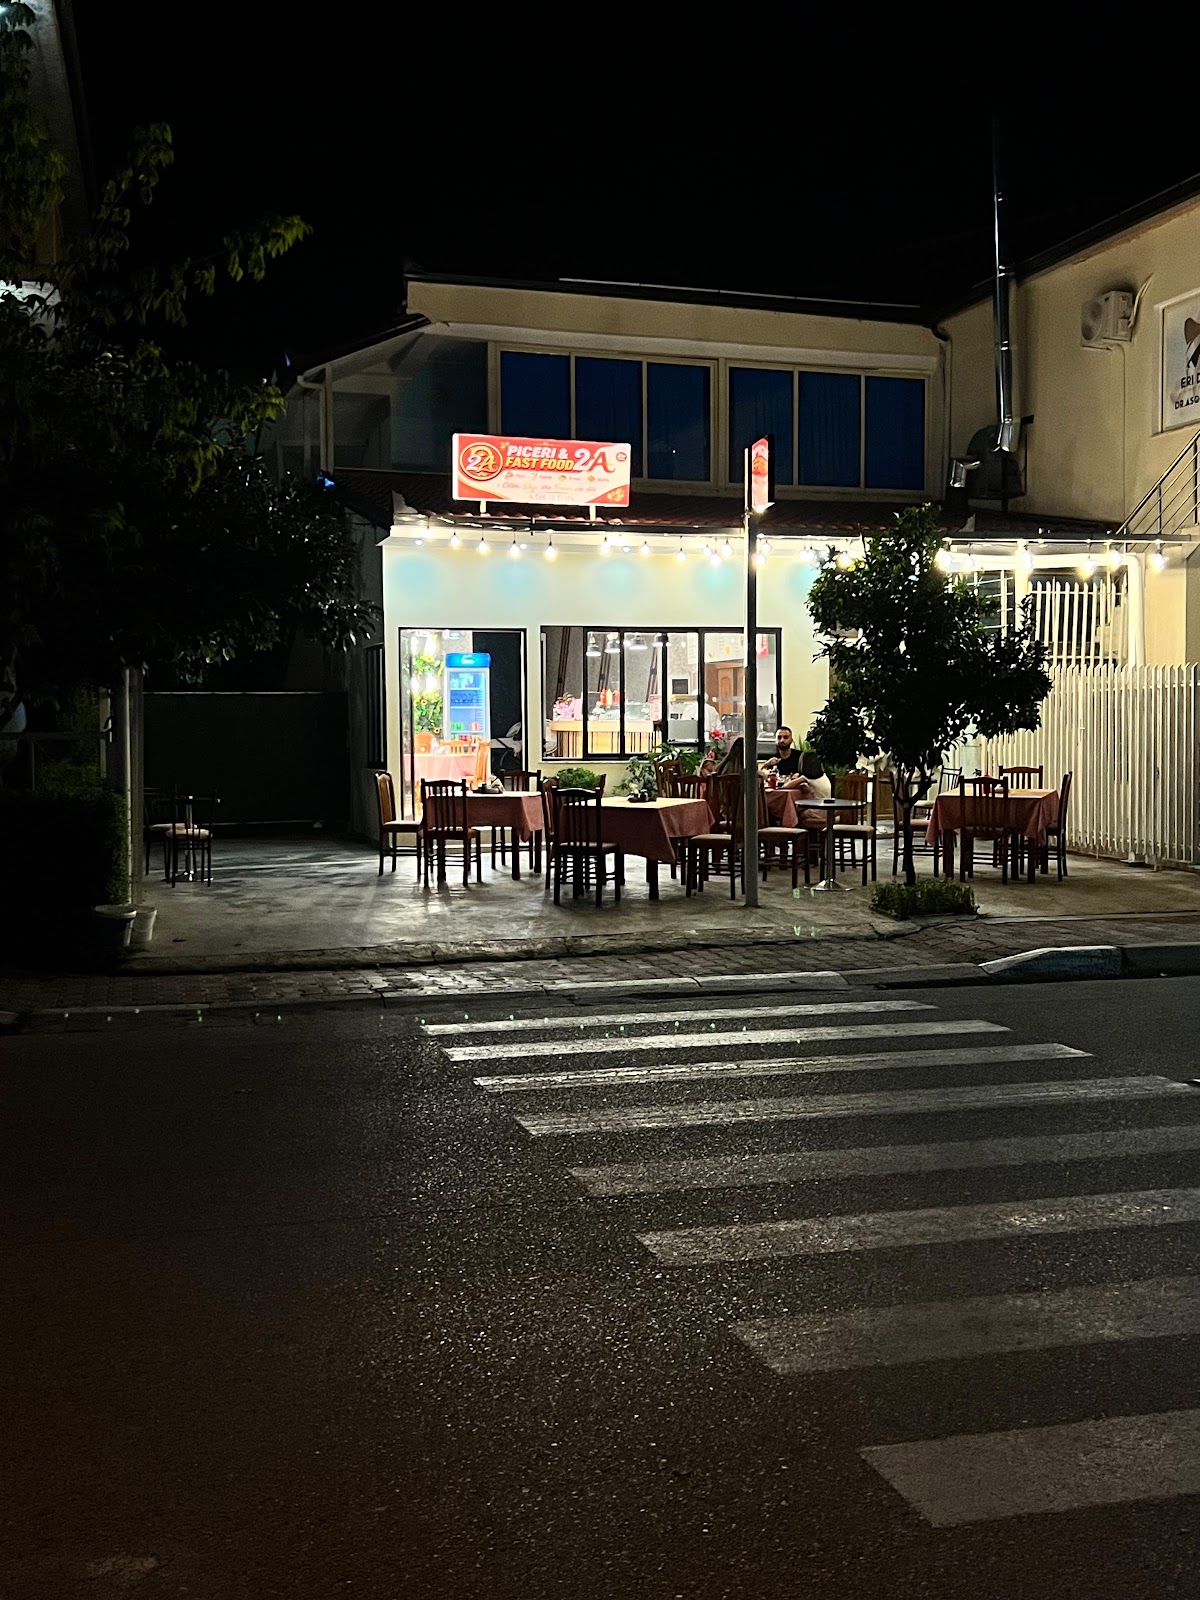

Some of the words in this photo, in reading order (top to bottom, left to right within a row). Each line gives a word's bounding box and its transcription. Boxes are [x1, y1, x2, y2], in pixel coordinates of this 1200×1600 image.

[1181, 375, 1194, 388] ERI
[507, 445, 557, 459] PICERI
[558, 448, 569, 459] &
[467, 453, 497, 472] 2A
[505, 458, 538, 469] FAST
[540, 460, 574, 471] FOOD
[573, 448, 615, 473] 2A
